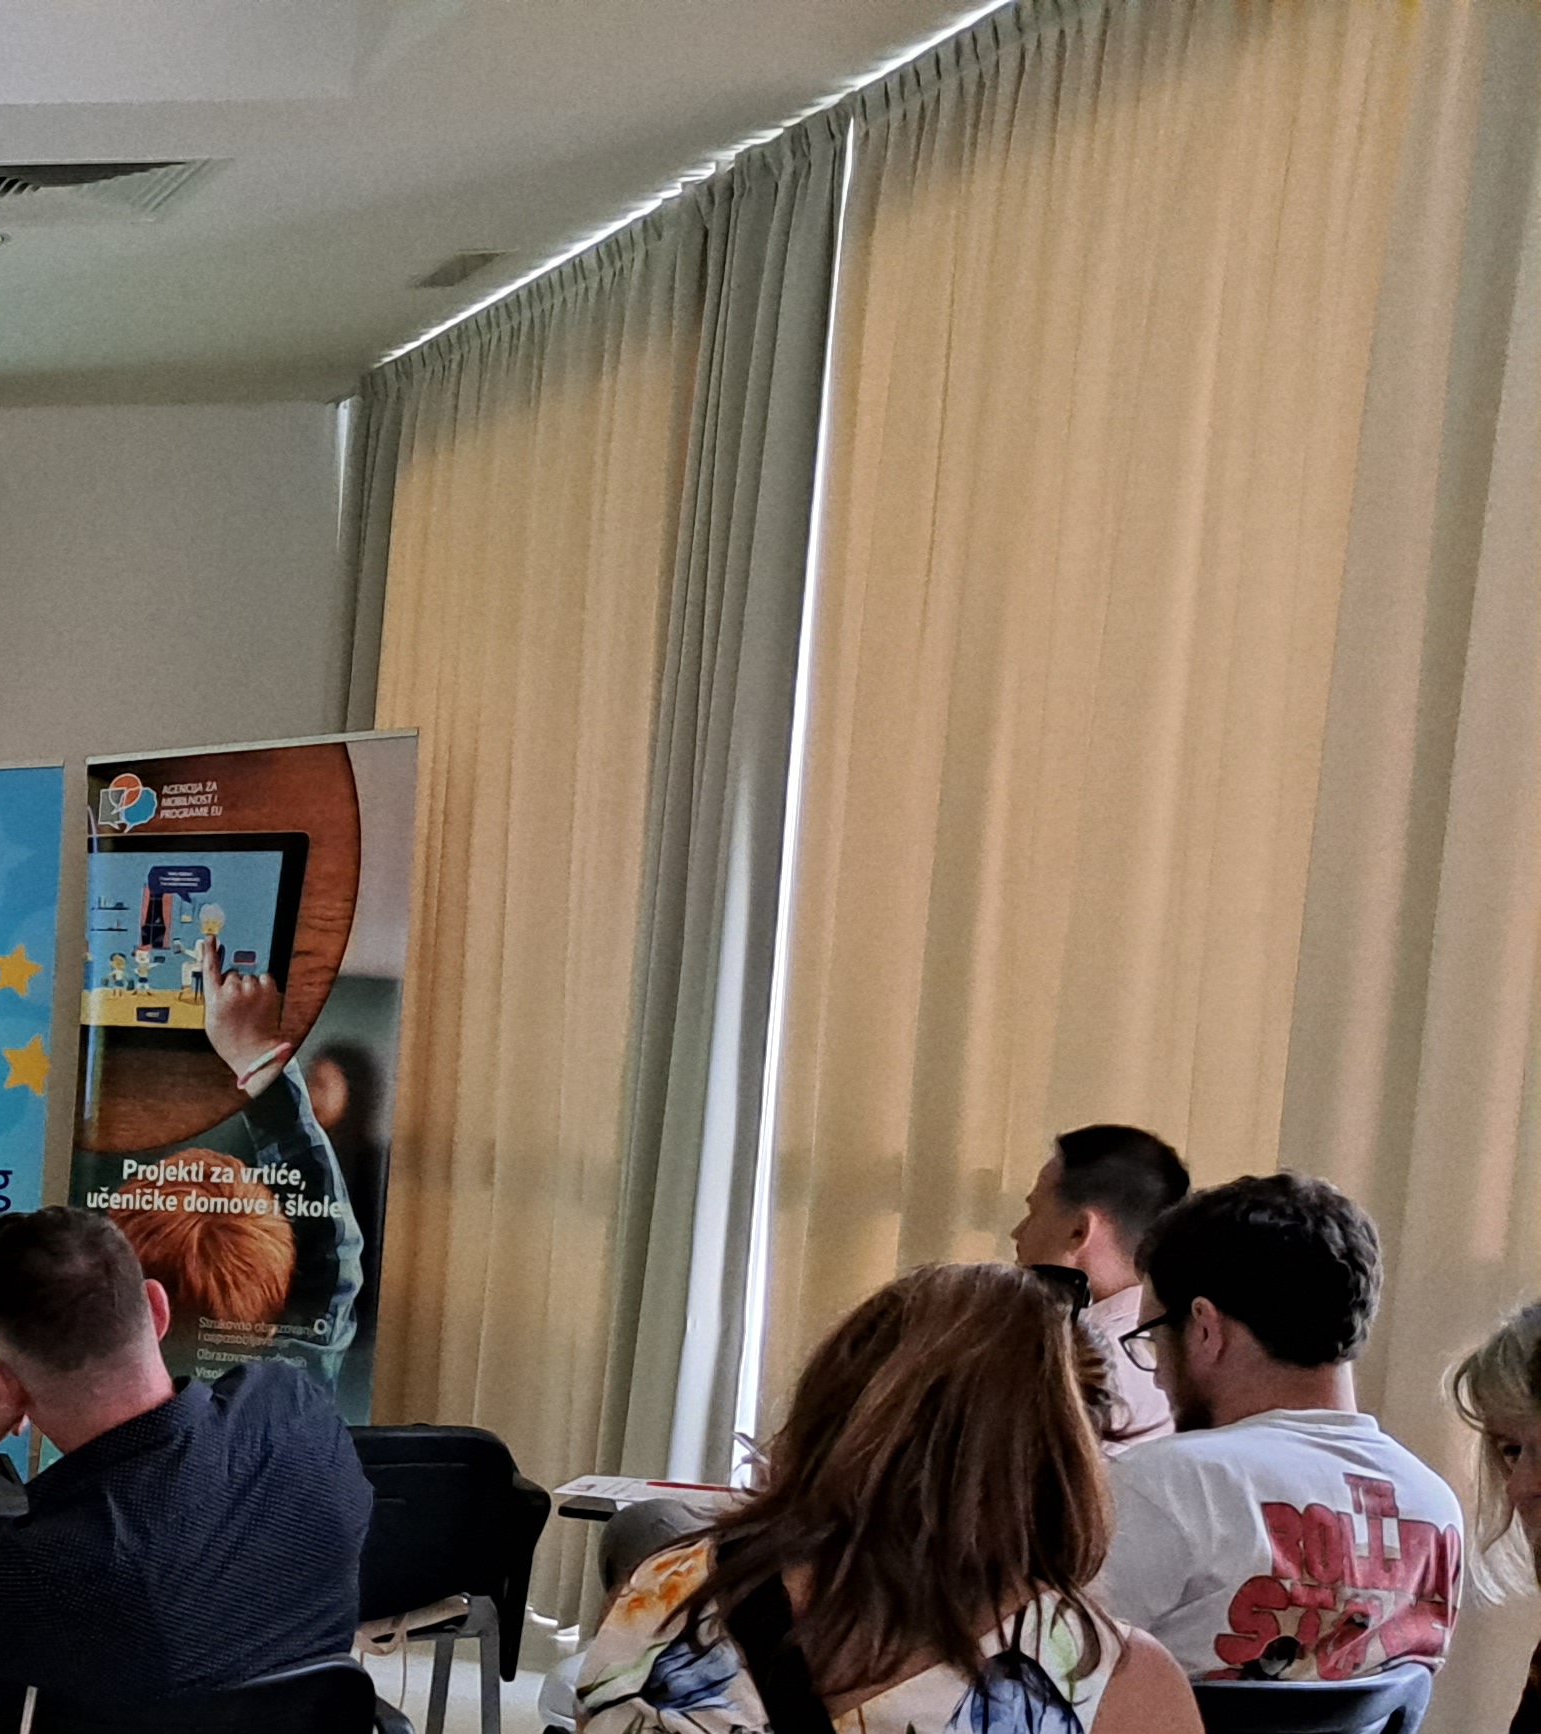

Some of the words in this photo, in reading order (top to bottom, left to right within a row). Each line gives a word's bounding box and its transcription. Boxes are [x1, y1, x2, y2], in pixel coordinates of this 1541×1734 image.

[121, 1158, 204, 1187] Projekti
[210, 1166, 234, 1184] za
[240, 1163, 306, 1191] vrtiće,
[86, 1187, 177, 1212] učeničke
[183, 1190, 266, 1216] domove
[272, 1196, 279, 1217] i
[284, 1193, 343, 1219] škole
